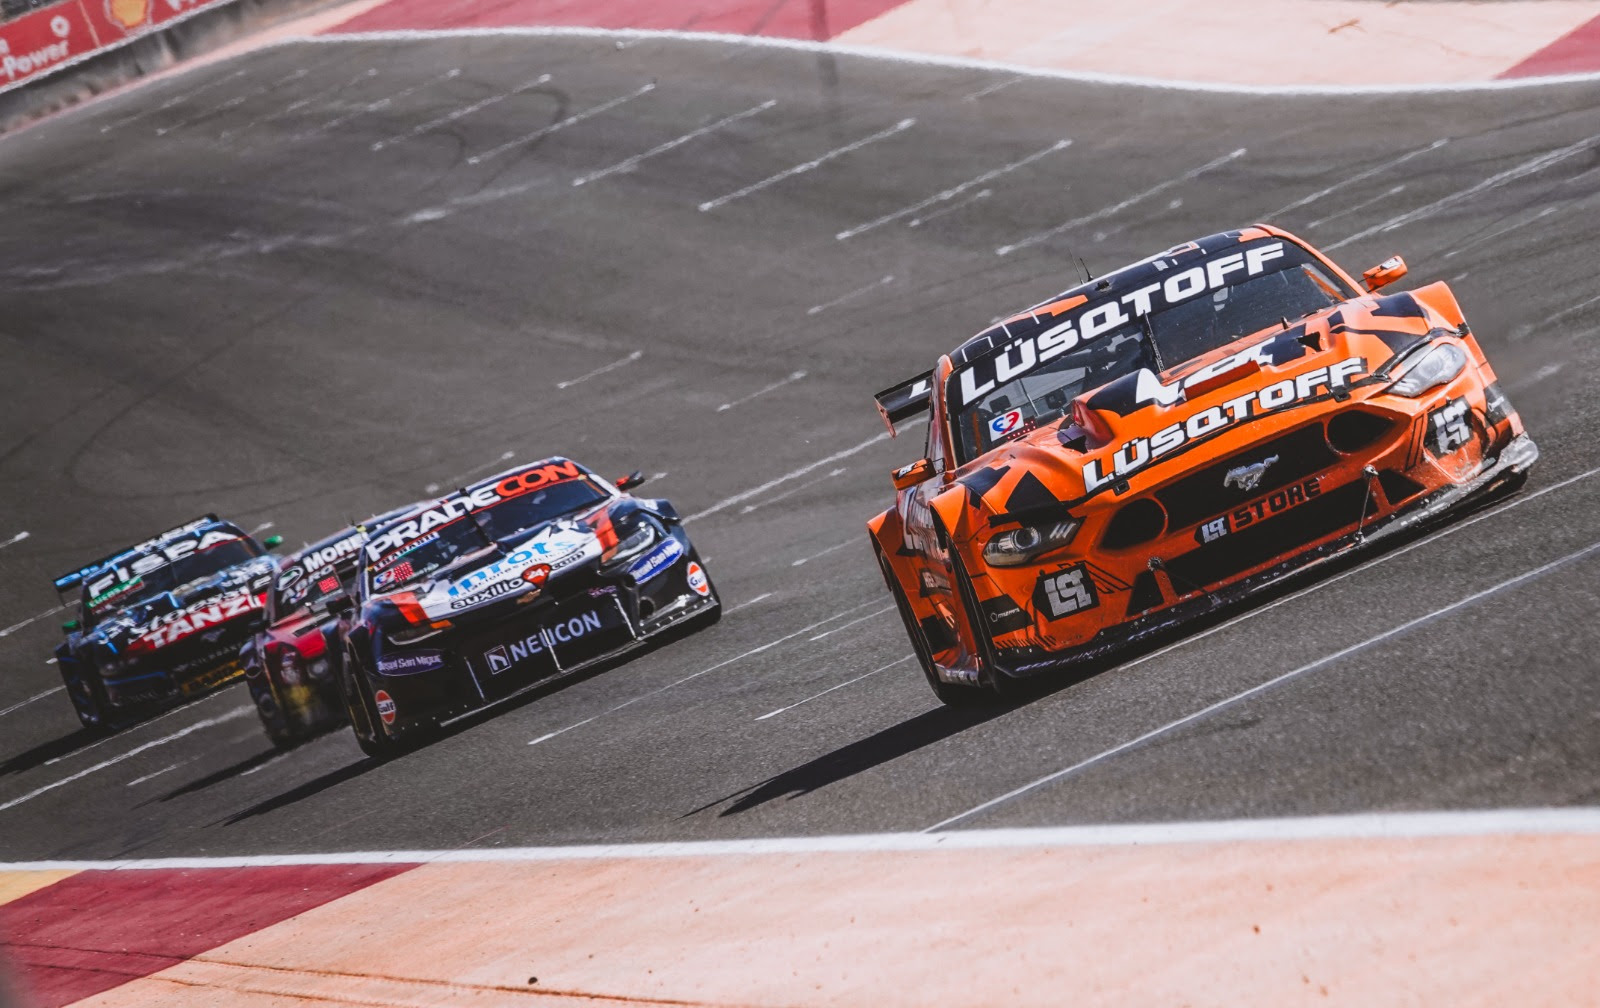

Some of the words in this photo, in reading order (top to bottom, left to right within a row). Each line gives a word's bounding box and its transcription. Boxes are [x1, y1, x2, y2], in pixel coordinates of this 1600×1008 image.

[366, 461, 580, 562] PRADECON
[1233, 478, 1322, 529] STORE
[88, 530, 238, 599] FISPA
